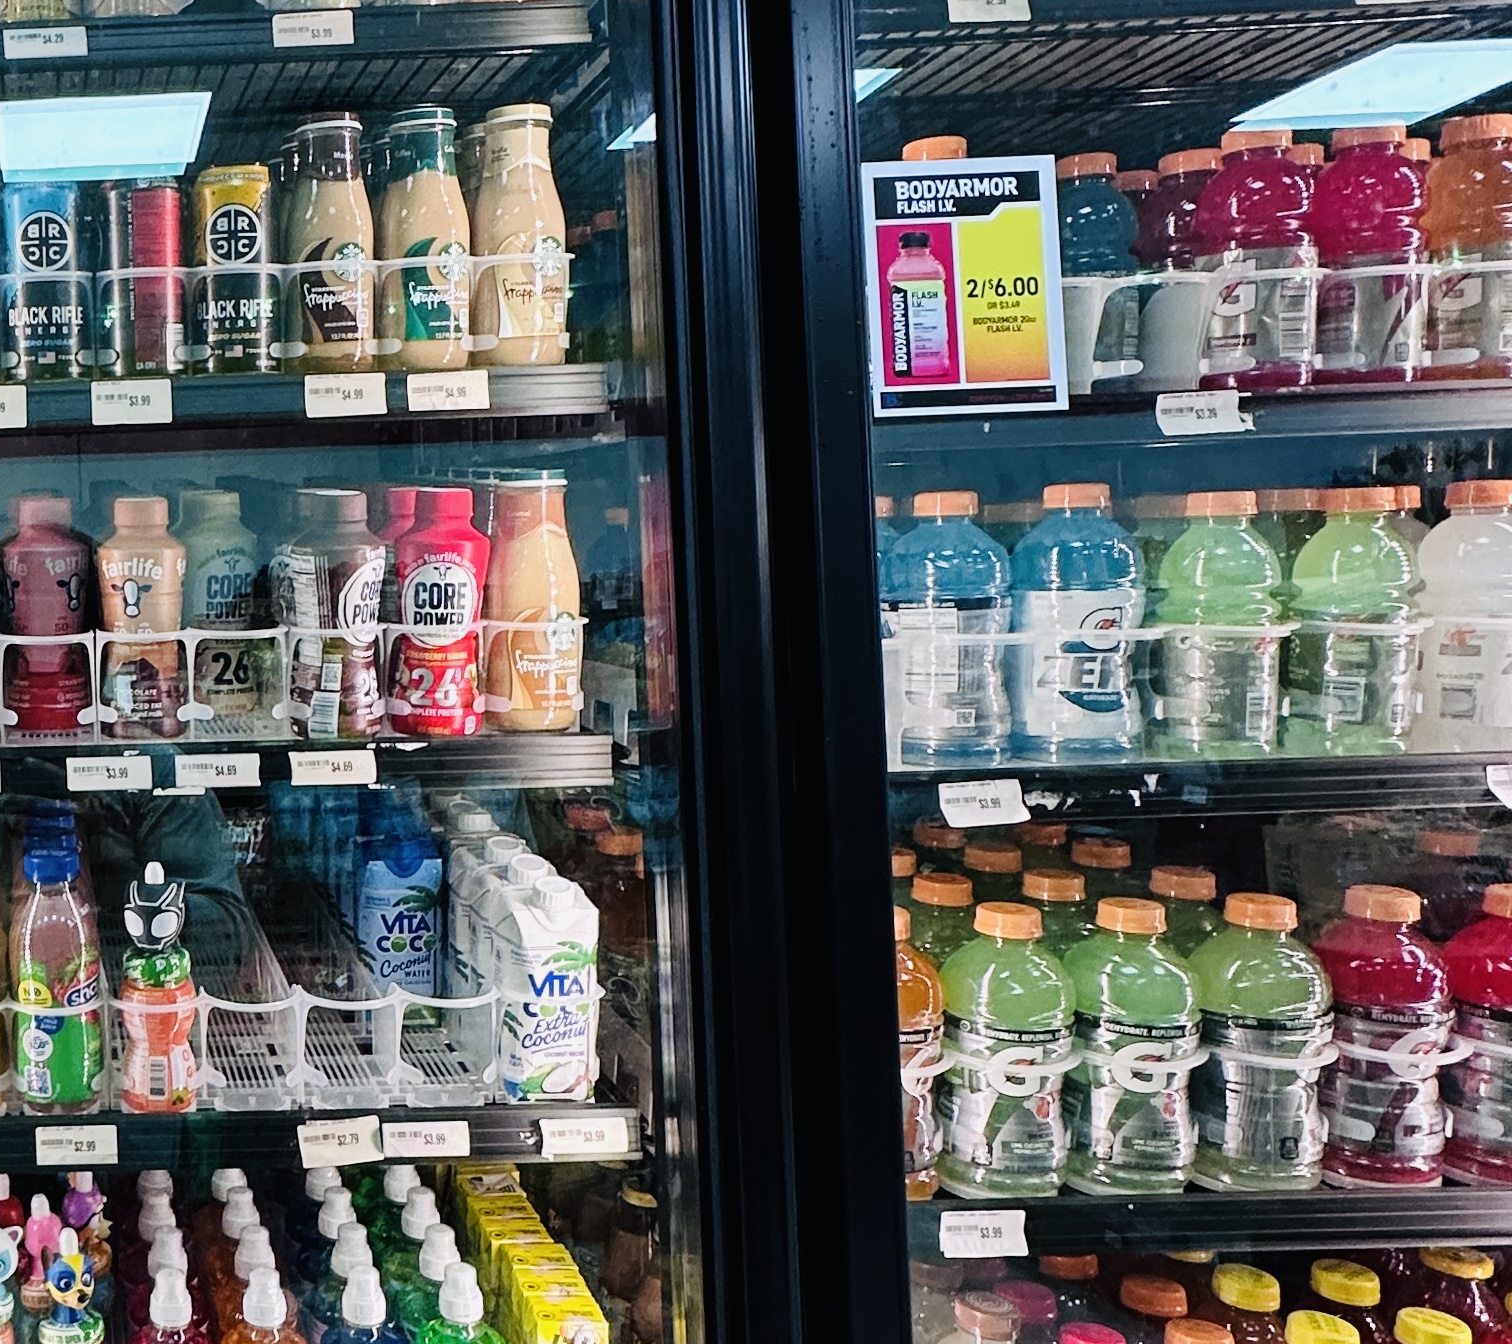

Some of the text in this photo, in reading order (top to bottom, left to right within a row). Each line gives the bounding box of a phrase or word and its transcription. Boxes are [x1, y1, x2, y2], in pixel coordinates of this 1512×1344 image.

[42, 33, 65, 45] $4.29
[310, 27, 333, 40] $3.99
[894, 176, 1019, 200] BODYARMOR
[896, 199, 957, 214] FLASH I.V.
[911, 290, 938, 300] FLASH
[966, 276, 1040, 300] 2/$6.00
[7, 305, 84, 327] BLACK RIFLE
[197, 299, 274, 320] BLACK RIFLE
[892, 291, 908, 372] BODYARMOR
[987, 325, 1010, 334] FLASH
[129, 395, 151, 406] $3.99
[341, 387, 364, 401] $4.99
[444, 386, 468, 399] $4.99
[206, 574, 251, 601] CORE
[413, 581, 468, 610] CORE
[211, 650, 250, 686] 26
[105, 767, 129, 780] $3.99
[380, 911, 431, 935] VITA
[379, 954, 432, 979] Coconut
[403, 969, 431, 979] WATER
[527, 971, 585, 998] VITA
[533, 1012, 579, 1035] Extra
[521, 1023, 586, 1050] Coconut
[73, 1140, 97, 1153] $2.99
[980, 1225, 1003, 1238] $3.99
